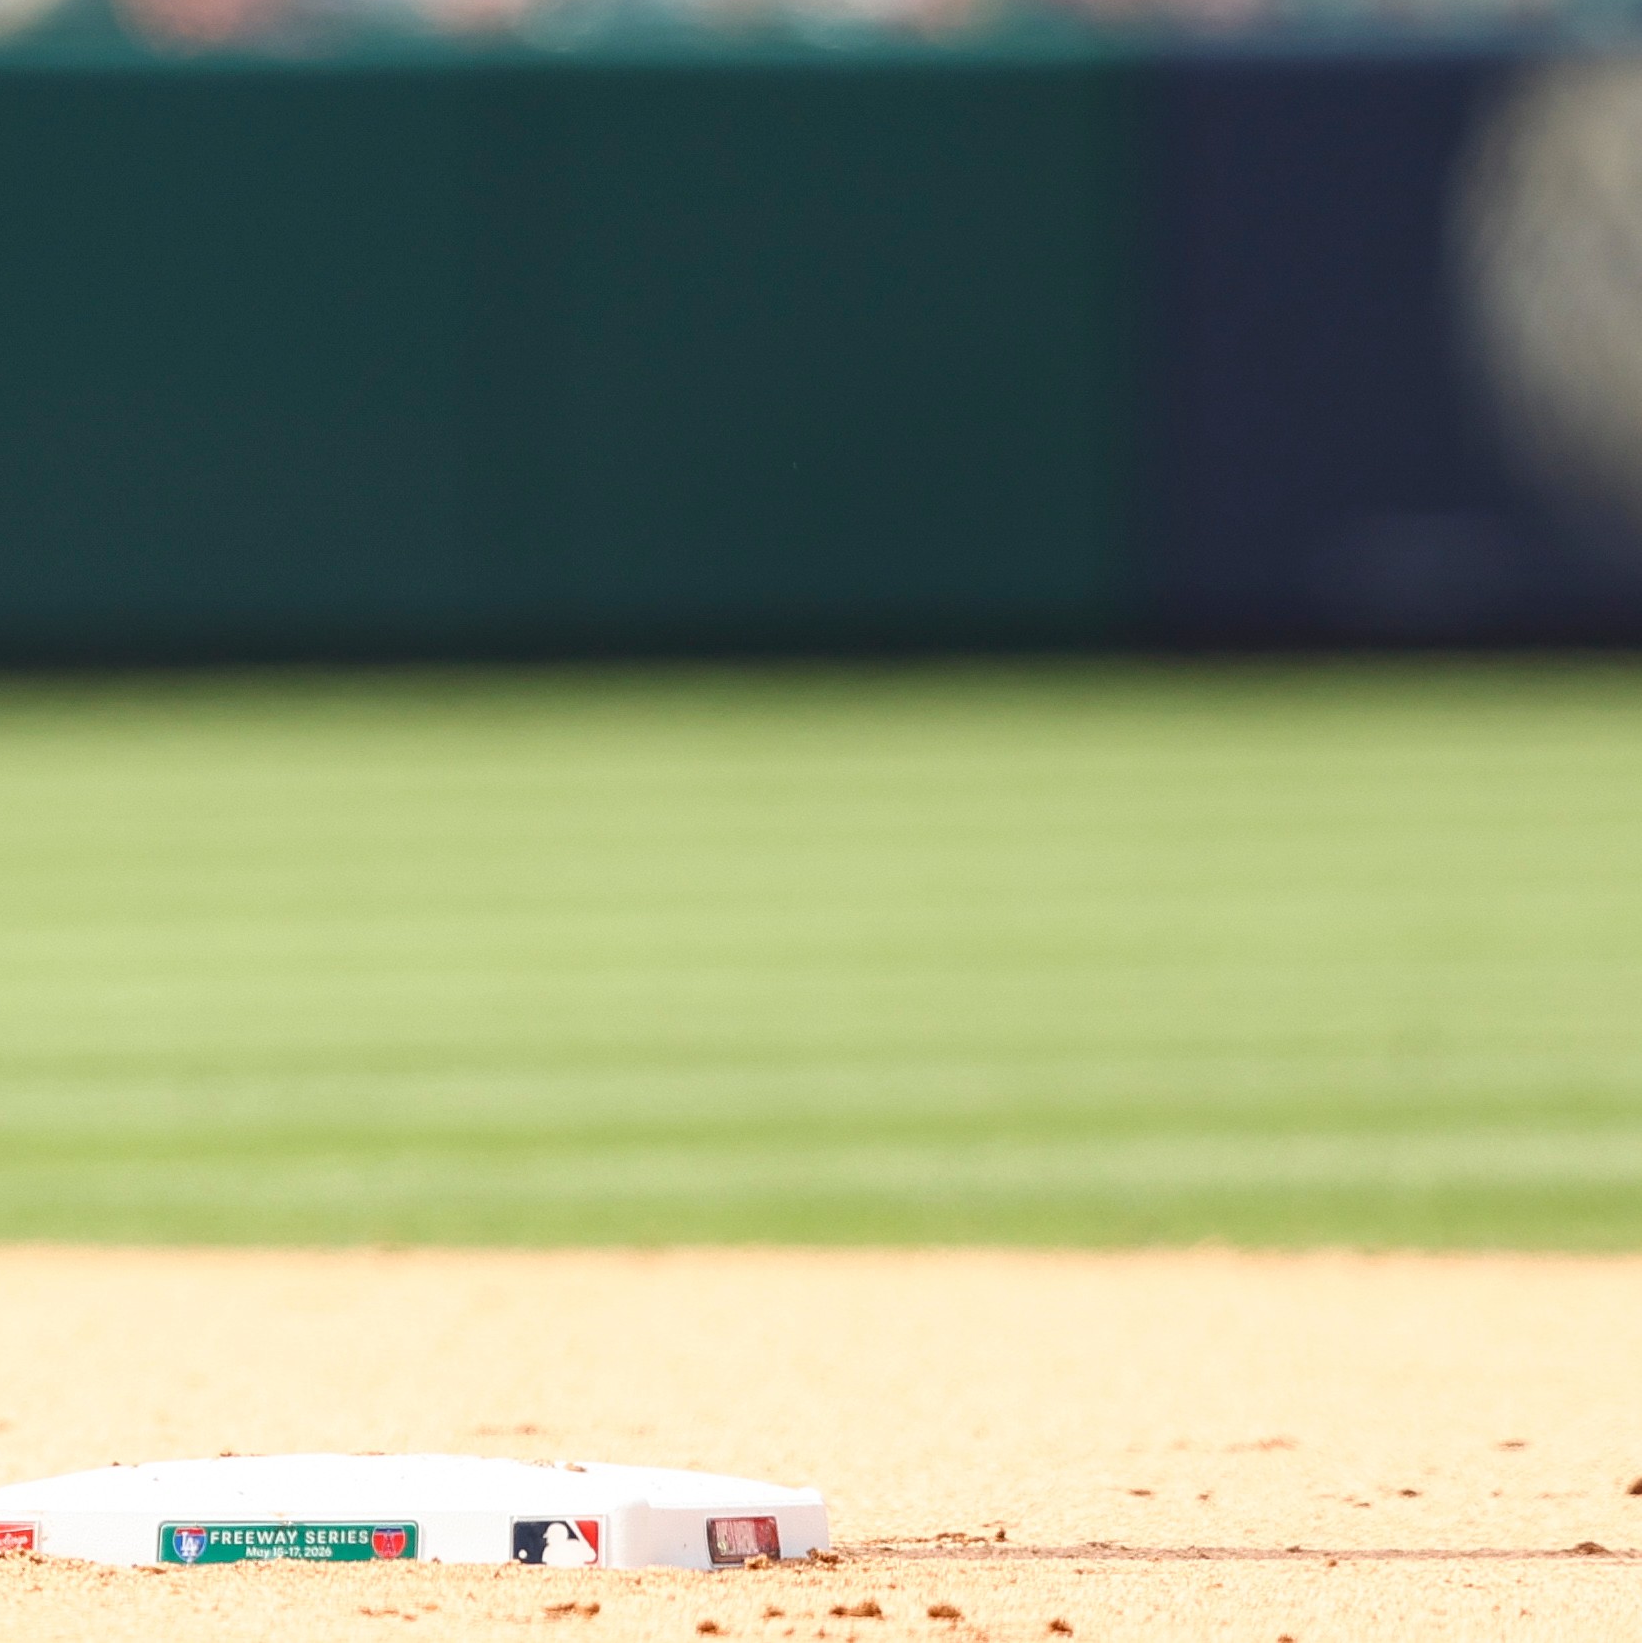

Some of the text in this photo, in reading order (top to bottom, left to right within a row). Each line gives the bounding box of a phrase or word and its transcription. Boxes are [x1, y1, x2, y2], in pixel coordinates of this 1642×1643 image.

[210, 1530, 370, 1545] FREEWAY SERIES
[246, 1546, 271, 1558] May
[304, 1546, 333, 1558] 2026
